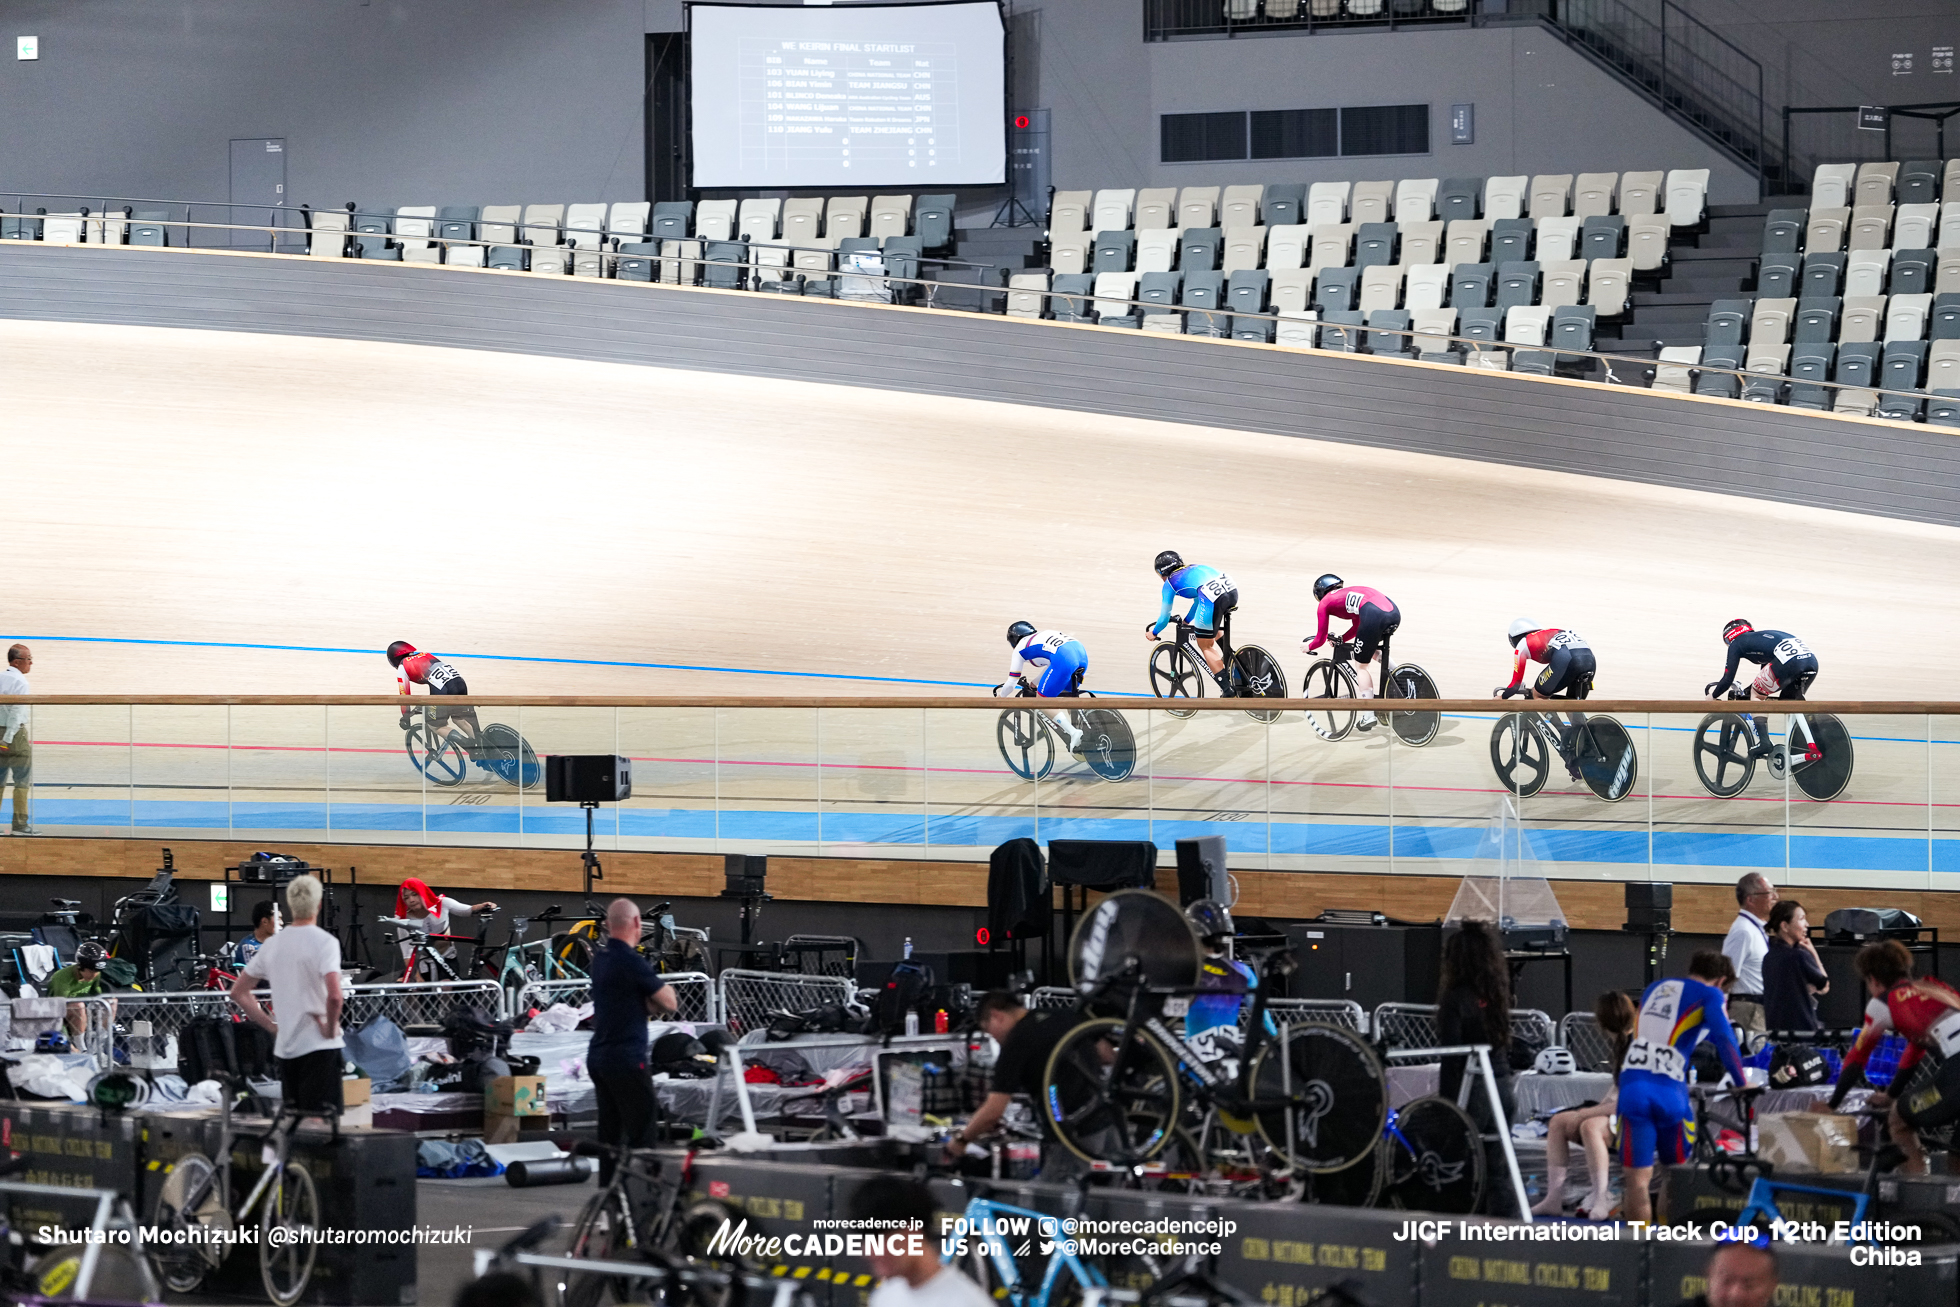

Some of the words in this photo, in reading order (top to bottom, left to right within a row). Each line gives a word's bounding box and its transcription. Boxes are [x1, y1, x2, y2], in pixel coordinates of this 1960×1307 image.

[781, 41, 796, 50] WE
[799, 42, 831, 51] KEIRIN
[833, 43, 861, 52] FINAL
[864, 44, 915, 53] STARTLIST
[804, 57, 828, 66] Name
[869, 59, 891, 67] Team
[915, 60, 930, 68] Nat
[785, 69, 809, 77] YUAN
[767, 91, 783, 99] 101
[786, 103, 813, 111] WANG
[842, 137, 849, 145] 0
[908, 137, 915, 145] 0
[1205, 579, 1222, 597] 106
[1346, 593, 1362, 608] 101
[1045, 635, 1064, 648] 110
[1778, 640, 1798, 657] 109
[431, 667, 450, 684] 104
